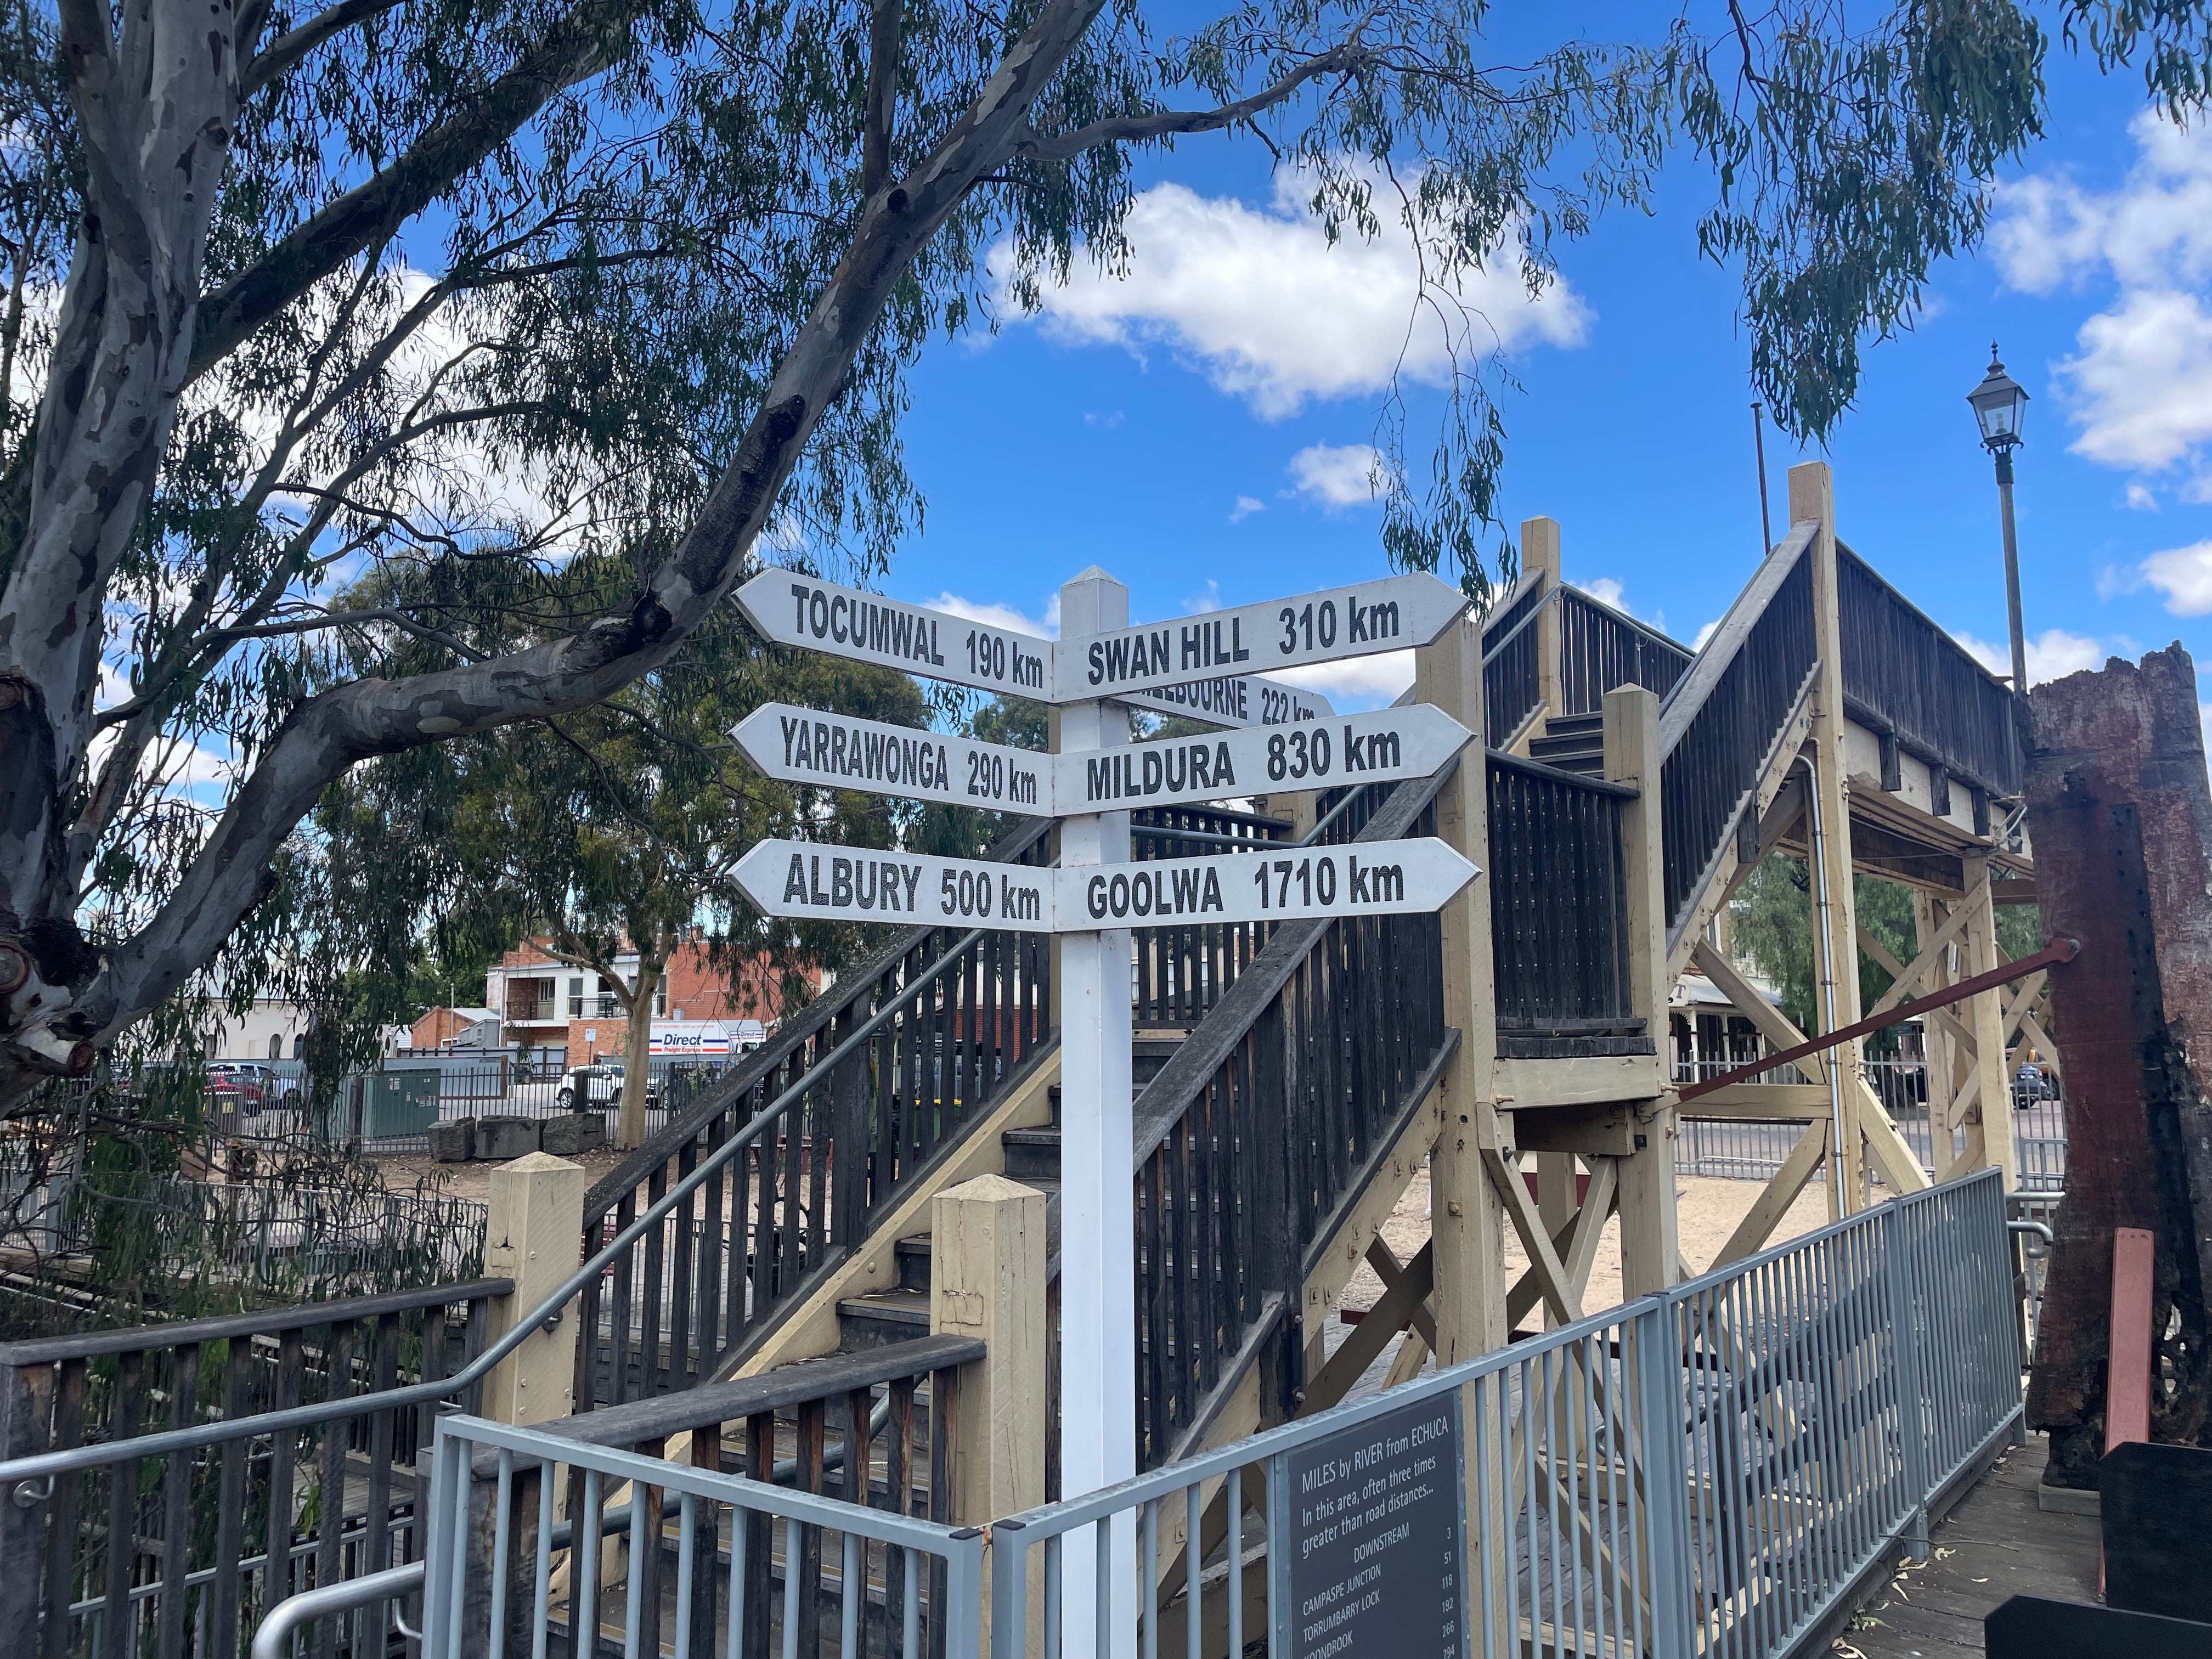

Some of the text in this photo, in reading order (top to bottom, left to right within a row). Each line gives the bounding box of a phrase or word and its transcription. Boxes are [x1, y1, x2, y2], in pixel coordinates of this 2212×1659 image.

[791, 584, 1043, 689] TOCUMWAL 190 km
[1087, 596, 1399, 686] SWAN HILL 310 km
[1141, 678, 1248, 720] BOURNE
[1262, 687, 1288, 725] 222
[780, 715, 1036, 804] YARRAWONGA 290 km
[1087, 725, 1401, 802] MILDURA 830 km
[783, 853, 1040, 921] ALBURY 500 km
[1087, 855, 1404, 919] GOOLWA 1710 km
[663, 1034, 702, 1045] Direct
[1302, 1416, 1448, 1493] MILES by RIVER from ECHUCA
[1302, 1455, 1436, 1527] In this area, often three times
[1302, 1483, 1434, 1560] greater than road distances...
[1354, 1522, 1409, 1563] DOWNSTREAM
[1303, 1527, 1451, 1616] CAMPASPE JUNCTION 3
[1303, 1550, 1452, 1644] TORRUMBARRY LOCK 51
[1442, 1597, 1453, 1613] 192
[1304, 1573, 1453, 1659] ONDROOK 118
[1442, 1620, 1454, 1638] 266
[1443, 1644, 1455, 1659] 294
